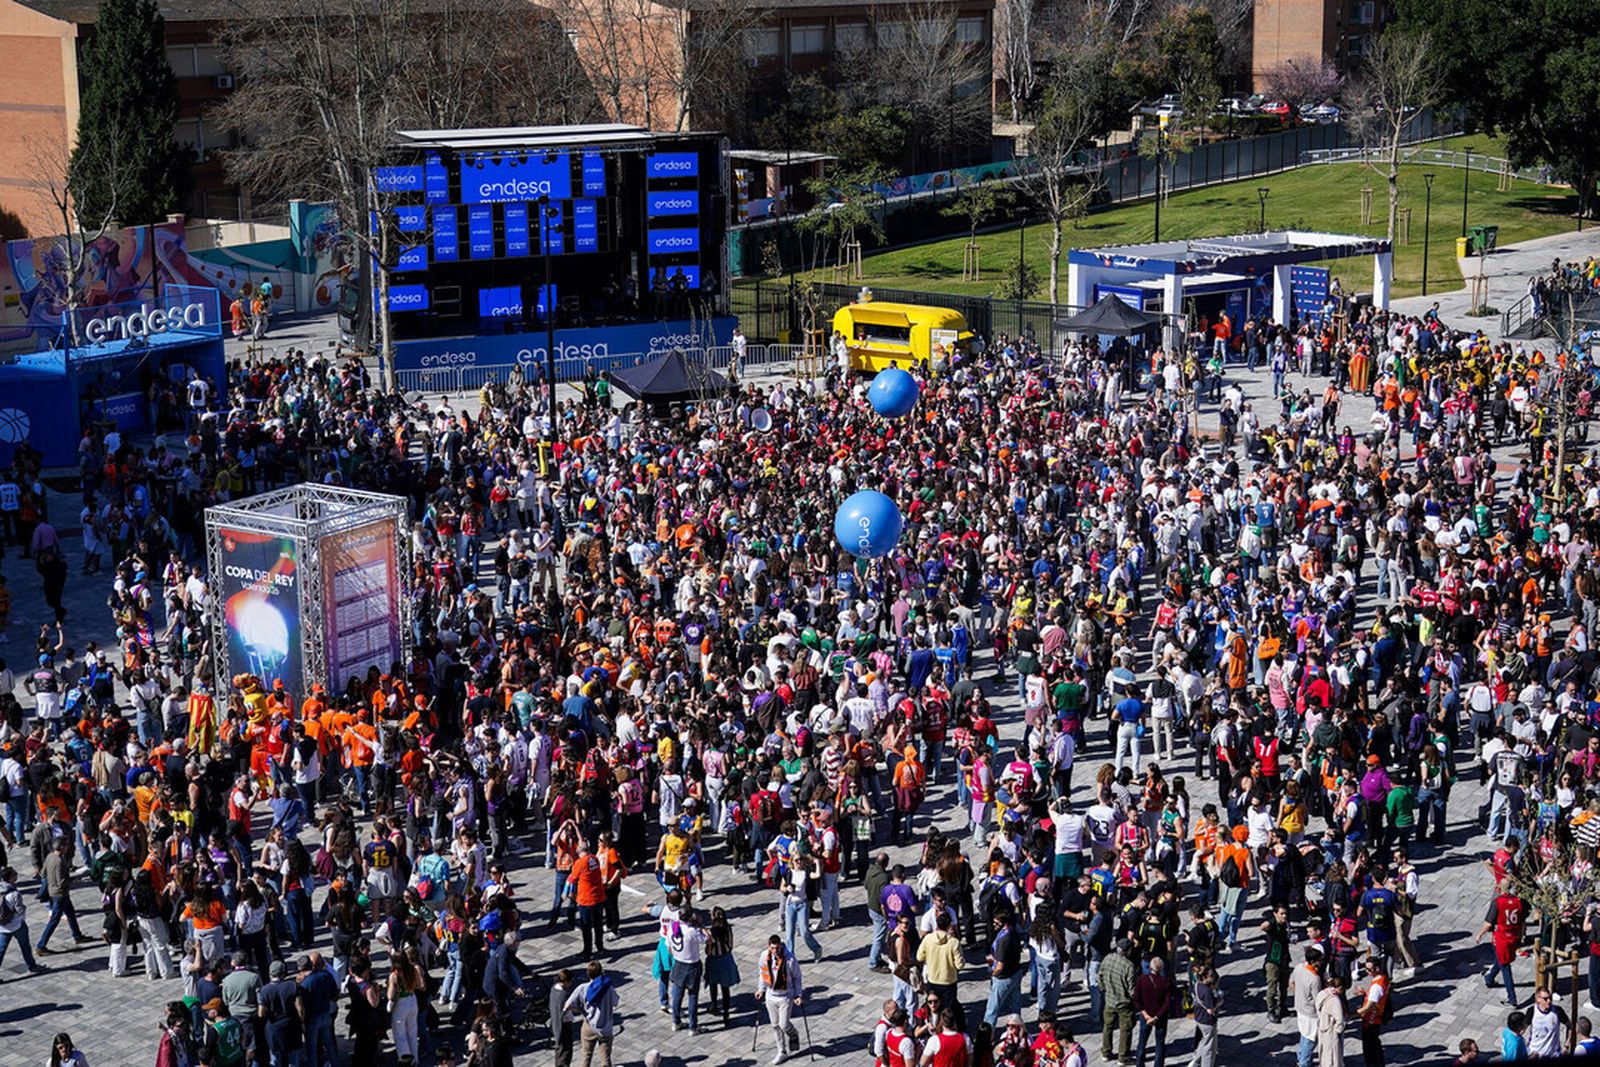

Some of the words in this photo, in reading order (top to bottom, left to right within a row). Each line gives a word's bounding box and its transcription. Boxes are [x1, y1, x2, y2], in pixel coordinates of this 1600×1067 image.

[654, 160, 692, 171] endesa
[479, 178, 551, 198] endesa
[655, 199, 693, 210] endesa
[655, 237, 693, 247] endesa
[388, 293, 422, 304] ndesa
[85, 303, 205, 343] endesa
[649, 333, 700, 347] endesa
[420, 351, 477, 367] endesa
[517, 341, 609, 366] endesa
[105, 403, 136, 416] ndesa
[225, 565, 254, 580] COPA
[254, 569, 274, 584] DEL
[274, 573, 294, 587] REY
[372, 850, 390, 868] 16
[1505, 909, 1518, 925] 16
[1147, 937, 1156, 952] 7
[227, 1028, 240, 1047] 44
